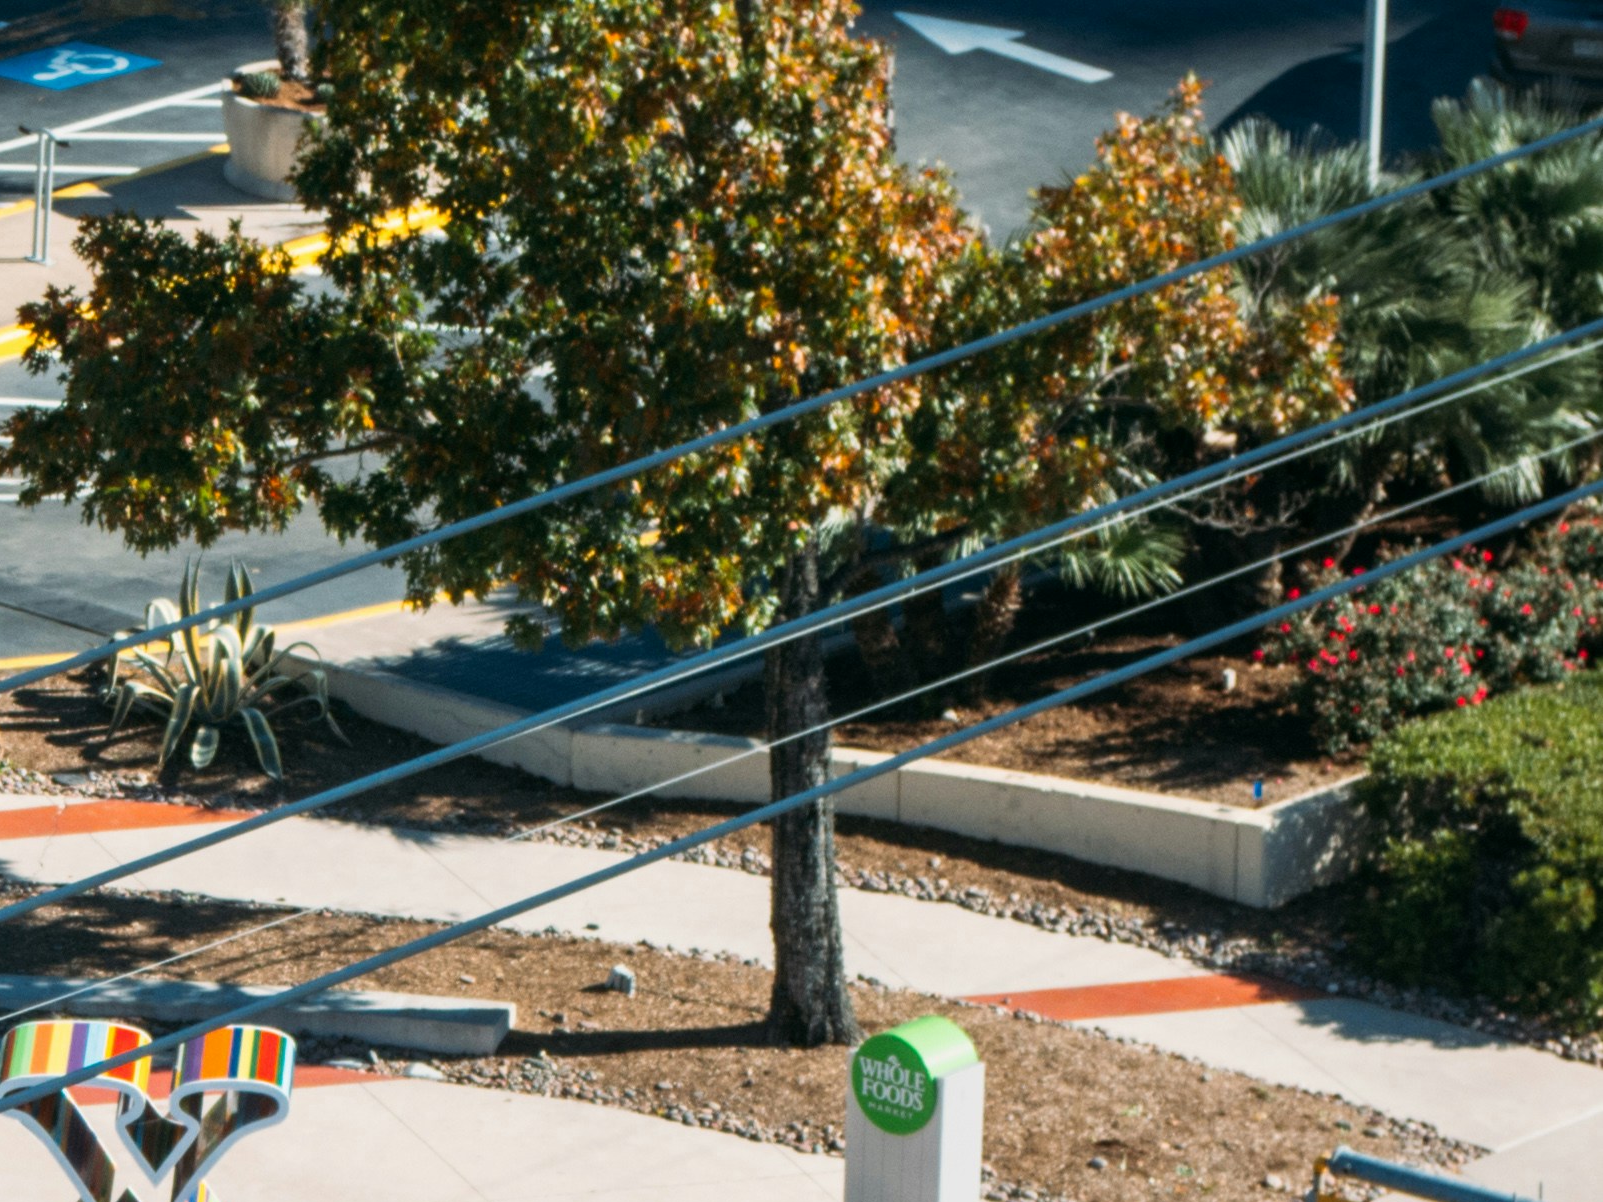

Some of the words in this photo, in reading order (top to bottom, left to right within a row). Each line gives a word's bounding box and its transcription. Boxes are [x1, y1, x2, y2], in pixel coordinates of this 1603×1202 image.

[859, 1056, 925, 1092] WHOLE
[862, 1078, 924, 1111] FOODS
[868, 1101, 914, 1119] MARKET
